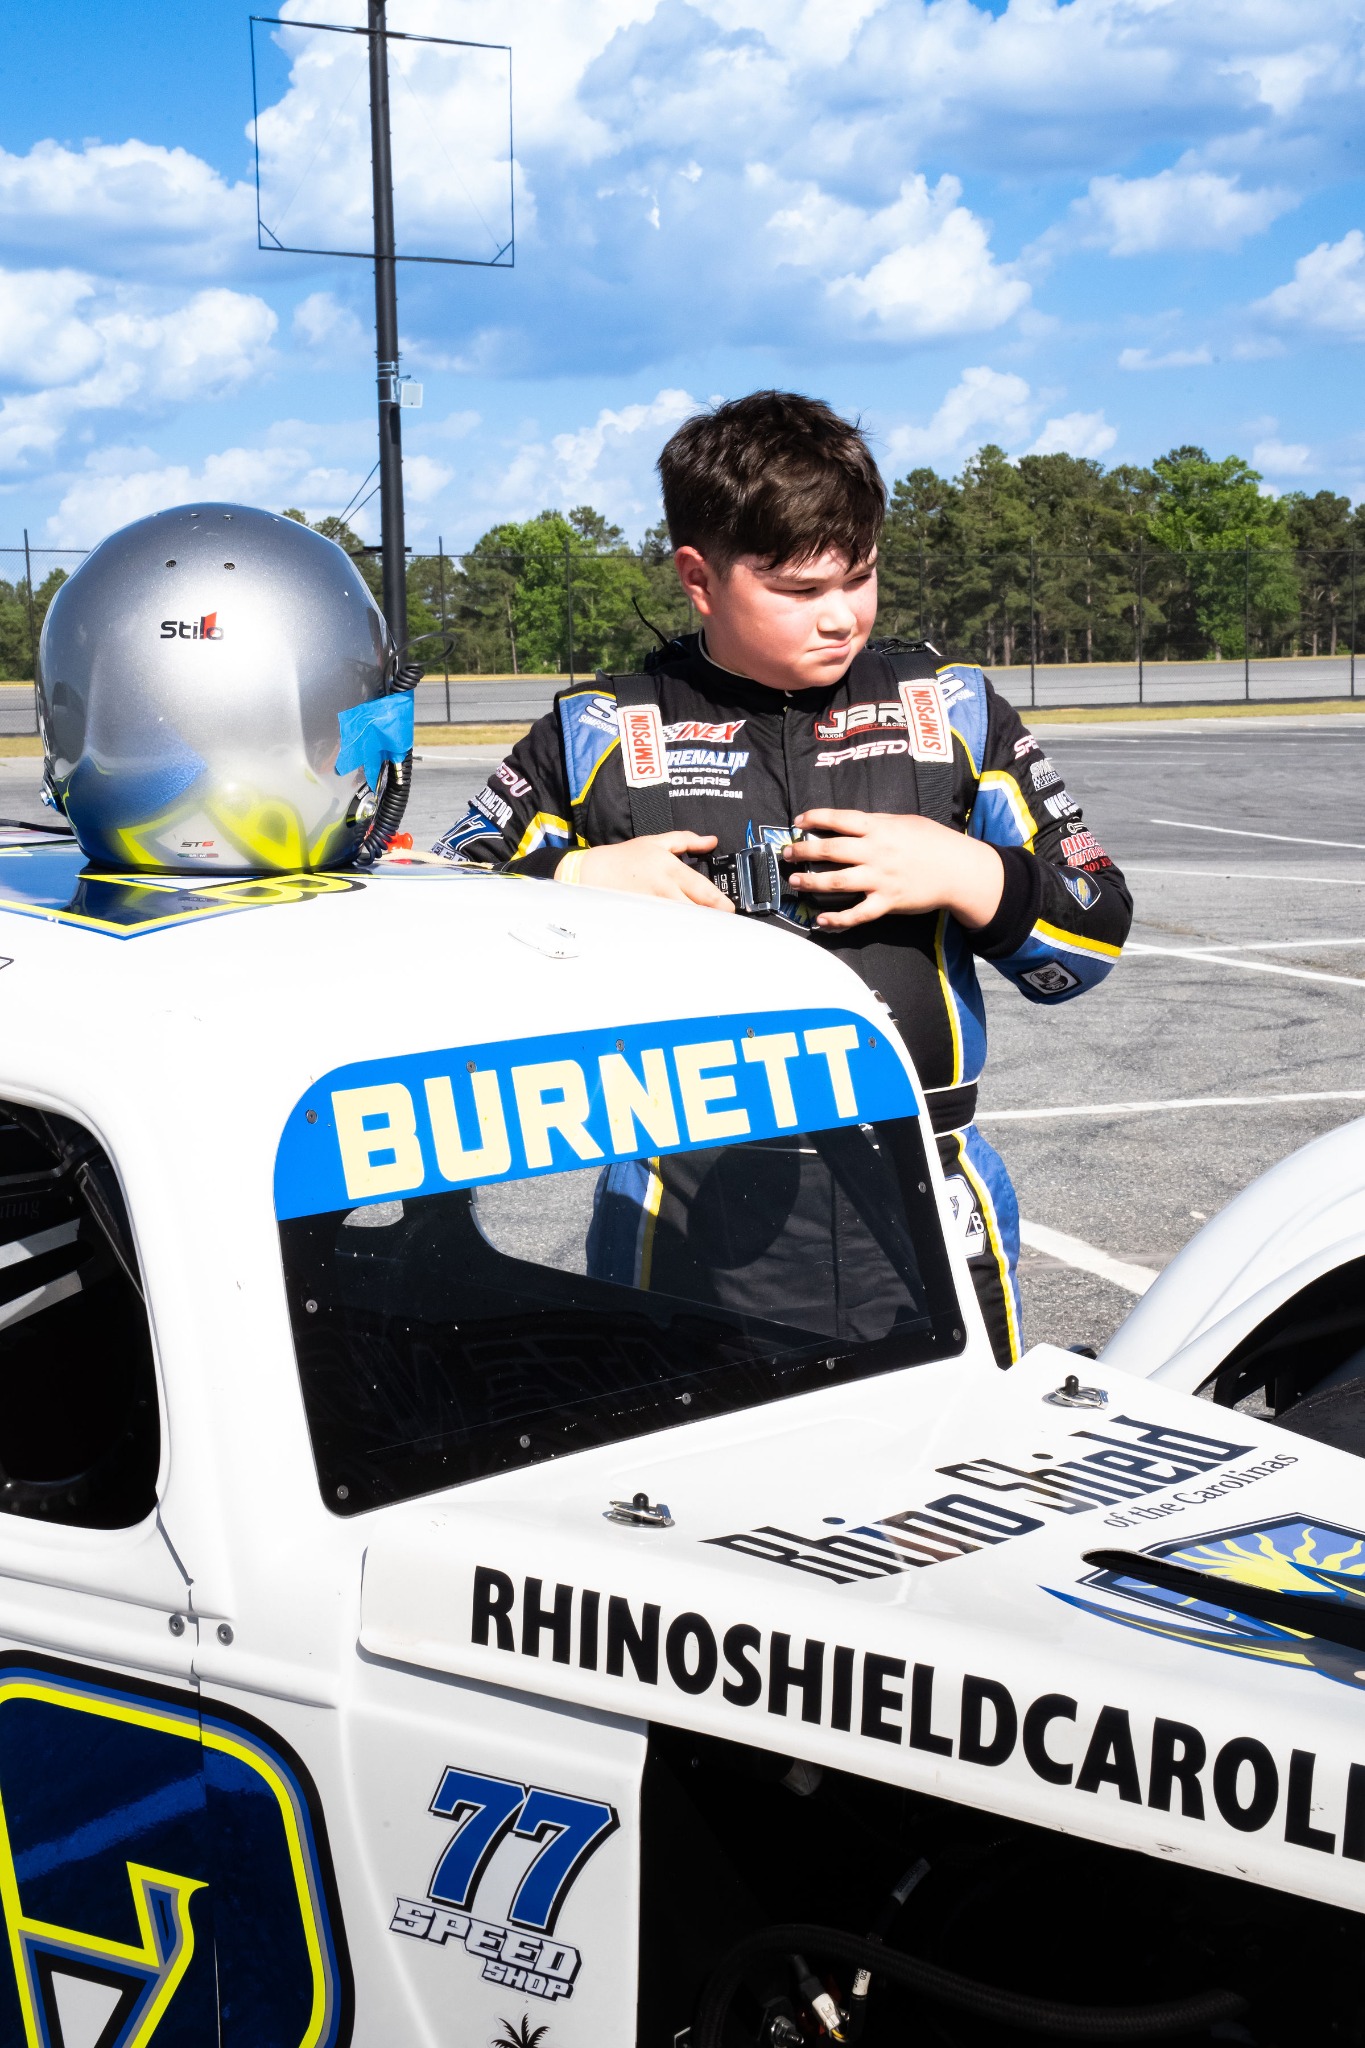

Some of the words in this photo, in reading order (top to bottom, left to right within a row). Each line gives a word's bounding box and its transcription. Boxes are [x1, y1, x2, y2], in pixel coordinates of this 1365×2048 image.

[160, 612, 224, 640] Stilo
[630, 714, 656, 775] SIMPSON
[675, 719, 747, 743] INEX
[916, 690, 942, 751] SIMPSON
[667, 750, 749, 775] RENALIN
[815, 740, 914, 768] SPEED
[668, 776, 731, 786] OLARIS
[668, 788, 743, 799] ENALINPWR.COM
[330, 1023, 860, 1201] BURNETT
[697, 1493, 1046, 1584] Rhino
[934, 1414, 1258, 1515] Shield
[1103, 1512, 1141, 1529] of
[1128, 1503, 1185, 1521] the
[1173, 1453, 1299, 1504] Carolinas
[427, 1765, 621, 1937] 77
[388, 1897, 582, 1985] SPEED
[481, 1957, 574, 2001] SHOP
